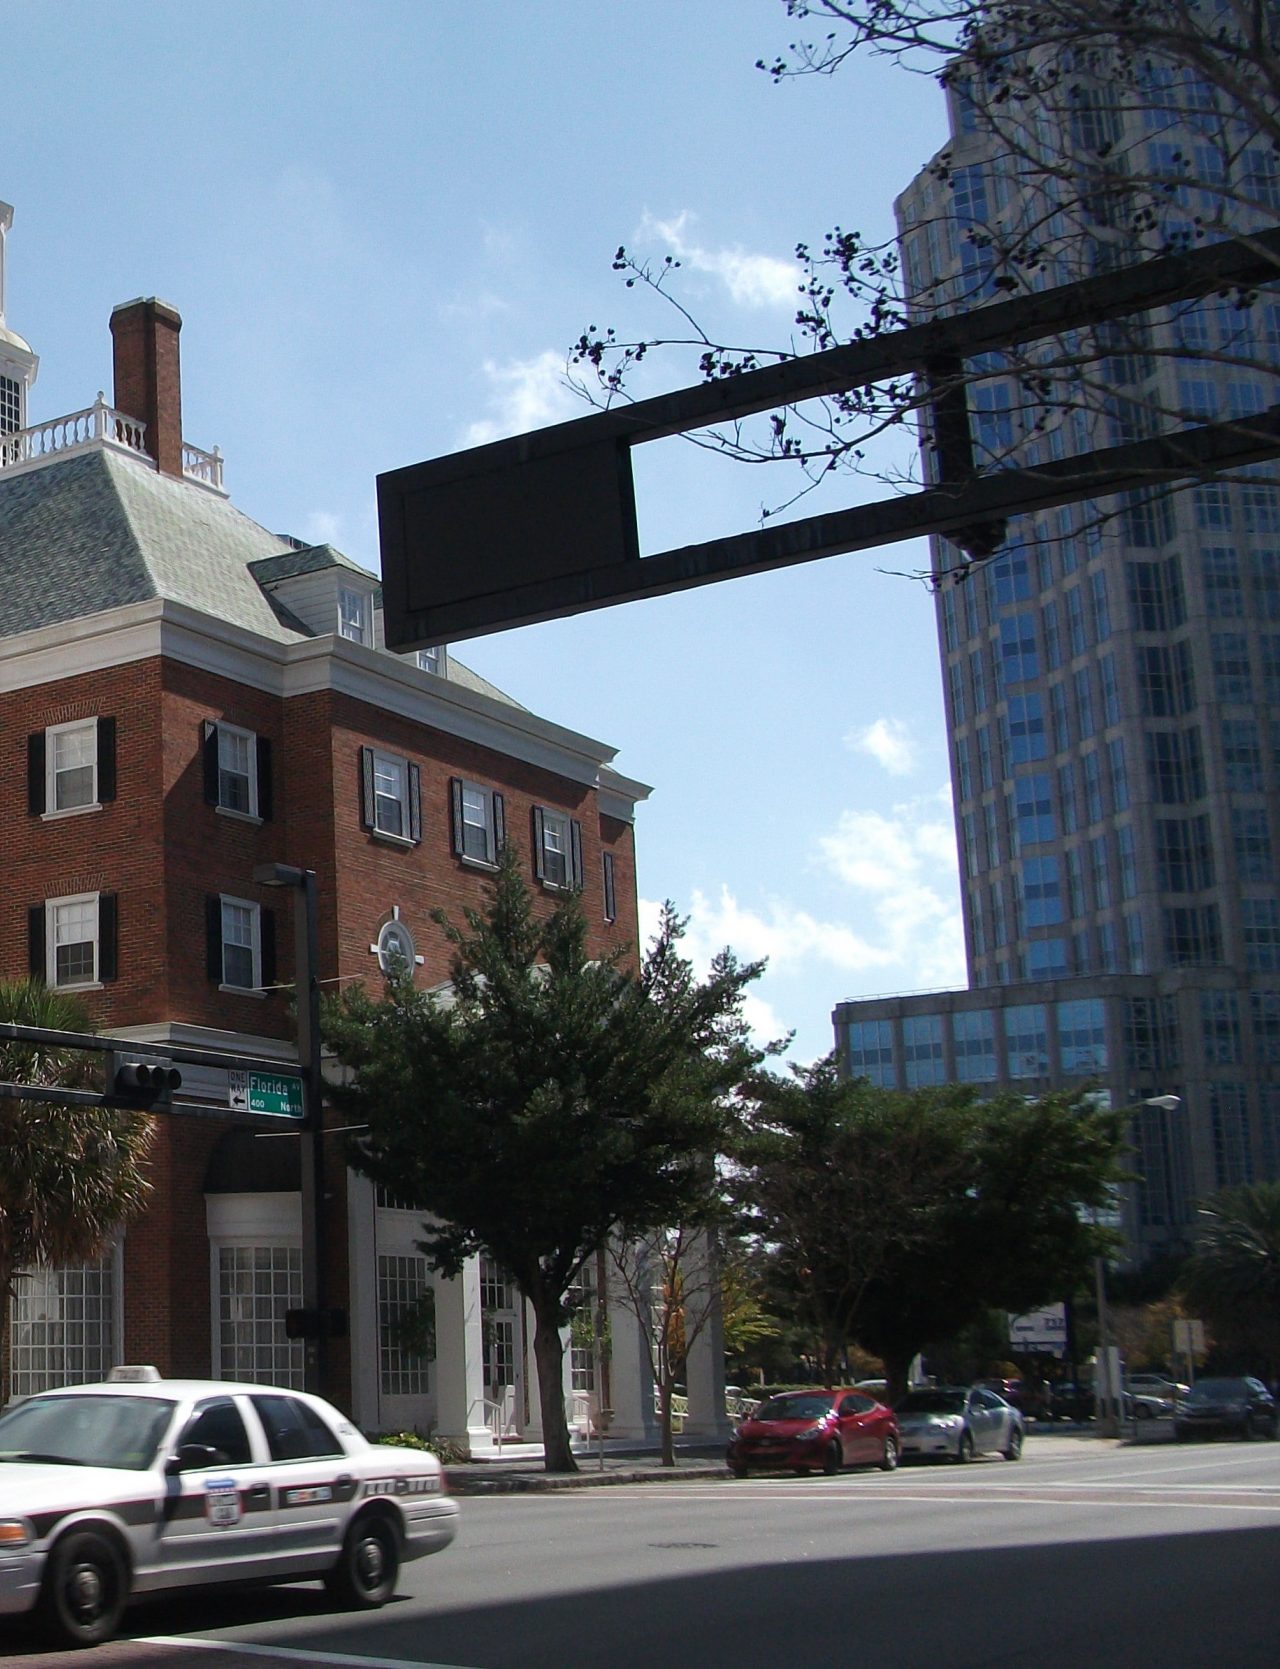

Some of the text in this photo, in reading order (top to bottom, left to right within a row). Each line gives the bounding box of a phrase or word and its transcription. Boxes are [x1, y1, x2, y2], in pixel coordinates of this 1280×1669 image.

[230, 1071, 246, 1083] ONE
[230, 1083, 246, 1096] WAY
[250, 1076, 288, 1096] Florida
[251, 1099, 302, 1113] 400 North
